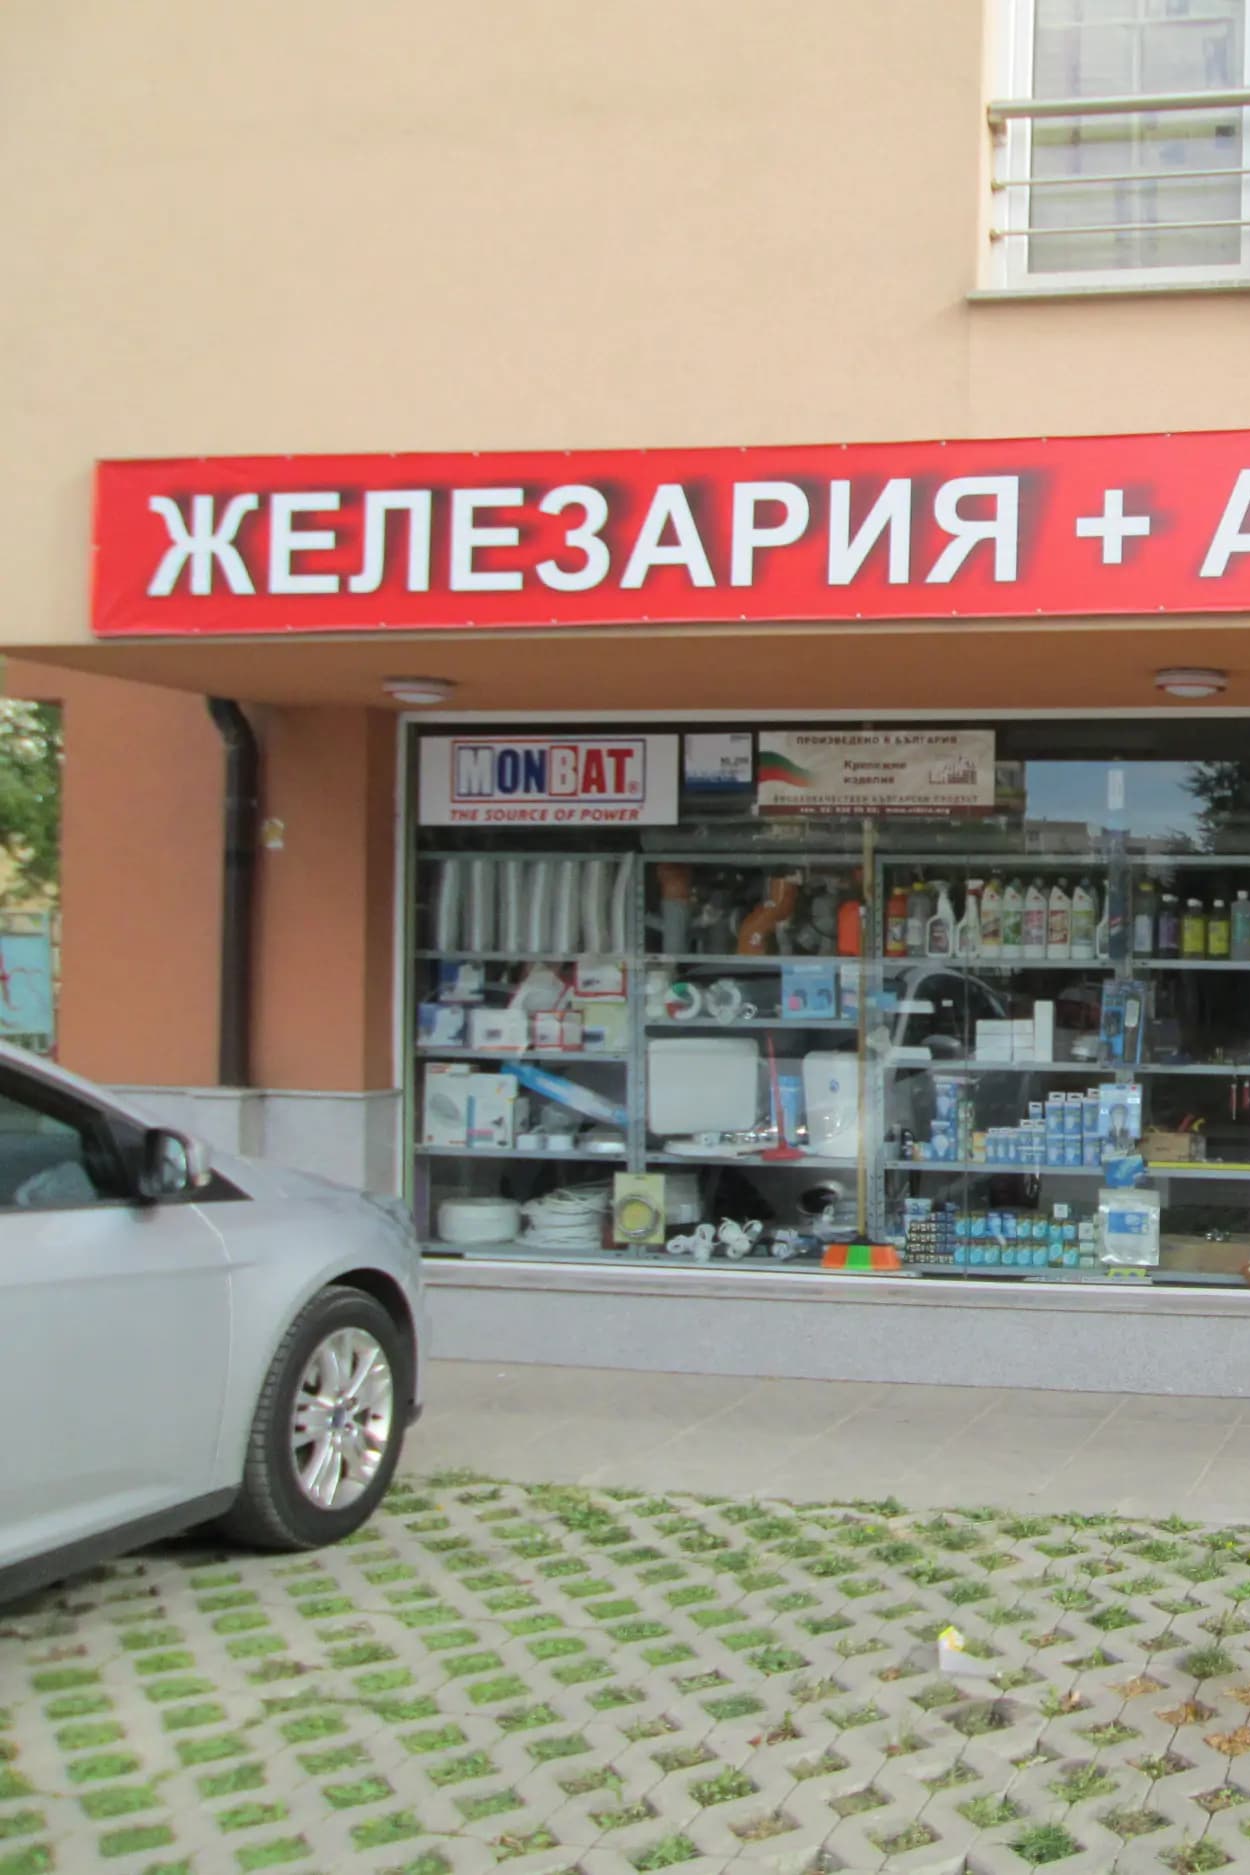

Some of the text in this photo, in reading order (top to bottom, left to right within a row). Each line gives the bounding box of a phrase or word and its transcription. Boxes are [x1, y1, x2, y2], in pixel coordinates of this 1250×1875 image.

[148, 474, 1020, 598] ЖЕЛЕЗАРИЯ
[1075, 488, 1152, 565] +
[796, 734, 880, 746] ПРОИЗВЕДЕНО
[894, 735, 958, 745] БЪЛГАРИЯ
[456, 745, 635, 797] MONBAT
[451, 807, 640, 822] THE SOURCE OF POWER
